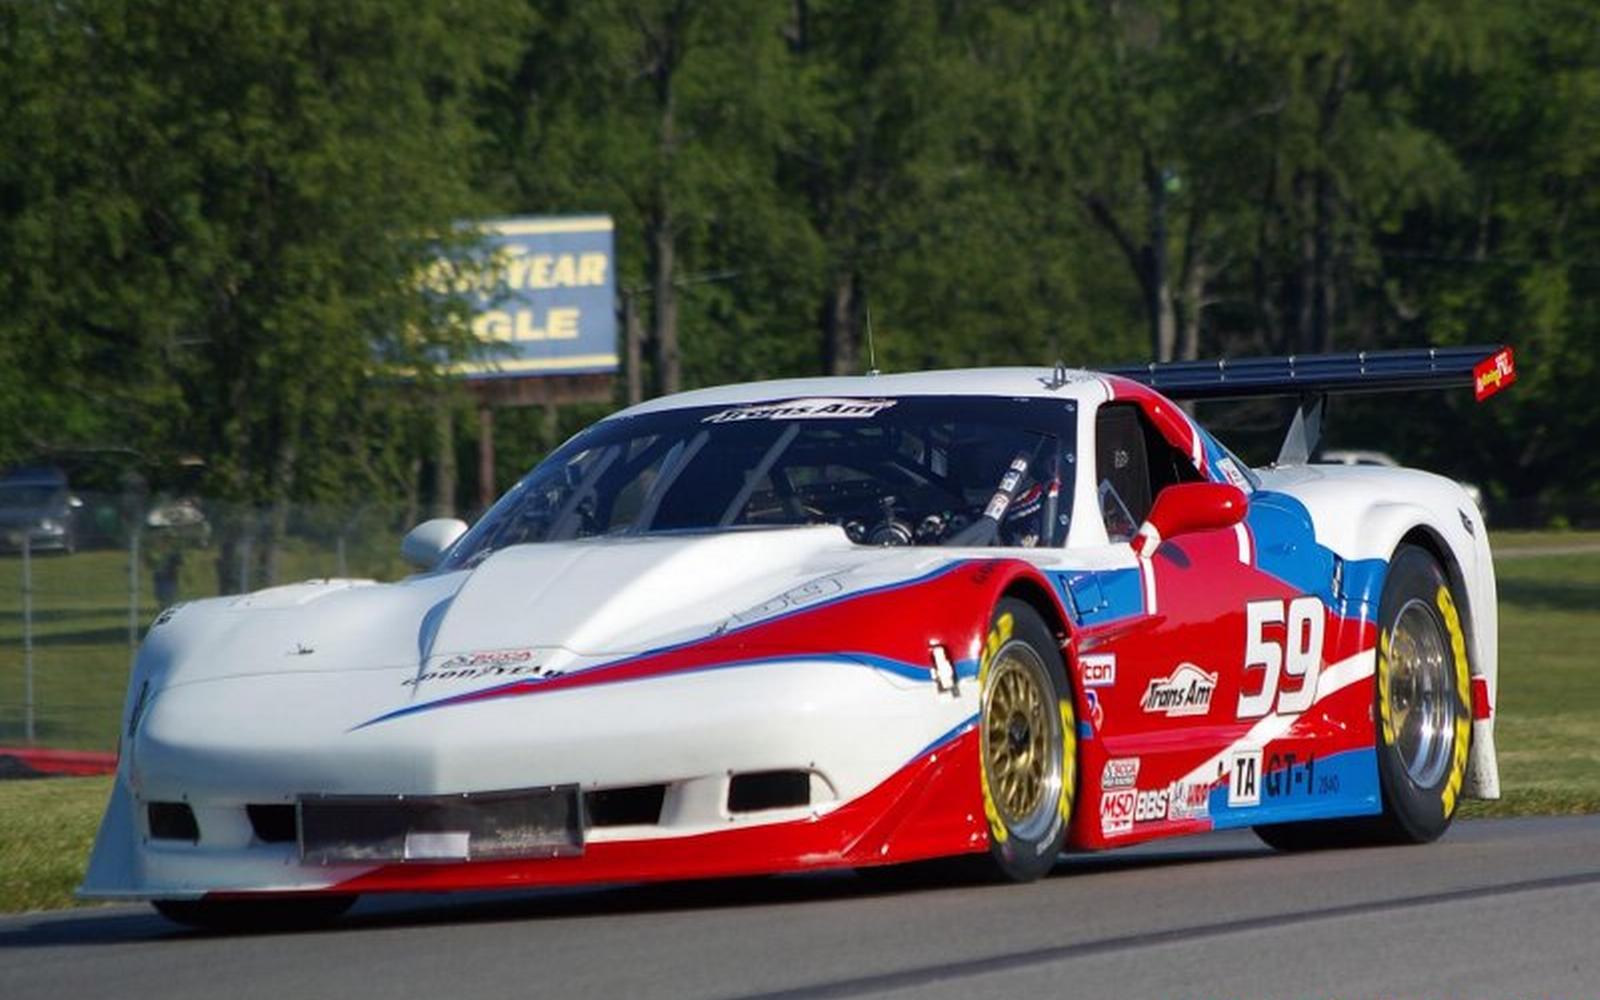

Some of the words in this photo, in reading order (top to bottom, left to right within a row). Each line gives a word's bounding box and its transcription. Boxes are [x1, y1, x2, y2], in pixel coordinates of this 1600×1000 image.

[1236, 595, 1325, 720] 59
[1145, 681, 1186, 708] Trans
[1184, 679, 1212, 705] Am
[1236, 757, 1256, 796] TA
[1264, 752, 1315, 798] GT-1
[1103, 792, 1135, 819] MSD
[1135, 787, 1168, 821] BBS
